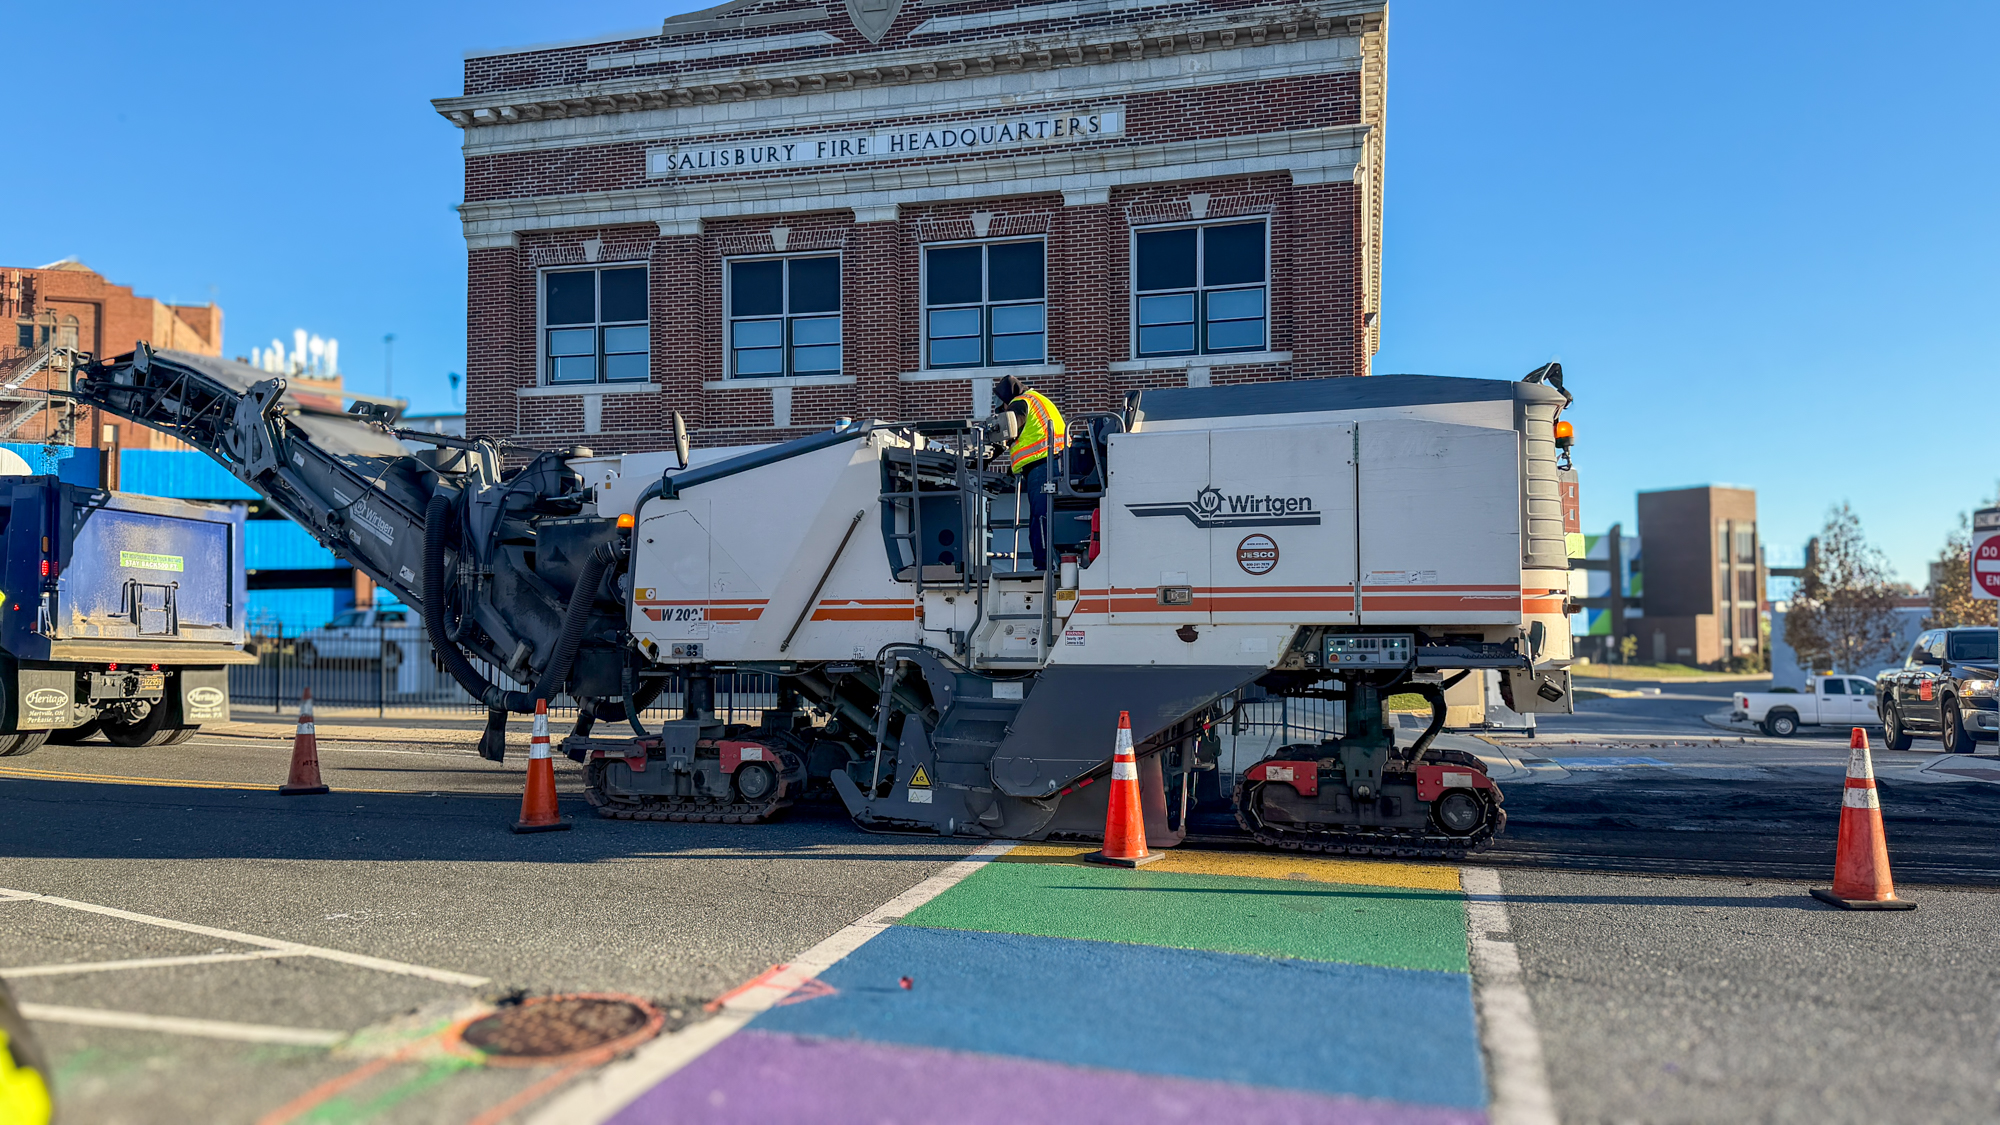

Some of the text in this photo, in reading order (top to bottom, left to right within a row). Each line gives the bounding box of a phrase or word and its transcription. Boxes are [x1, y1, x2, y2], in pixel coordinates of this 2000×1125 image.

[667, 115, 1099, 170] SALISBURY FIRE HEADQUARTERS
[1203, 494, 1312, 517] W Wirtgen
[365, 507, 394, 536] Wirtgen
[1241, 551, 1275, 559] JESCO
[1982, 546, 1998, 557] DO
[662, 608, 674, 621] W
[28, 691, 66, 706] Heritage
